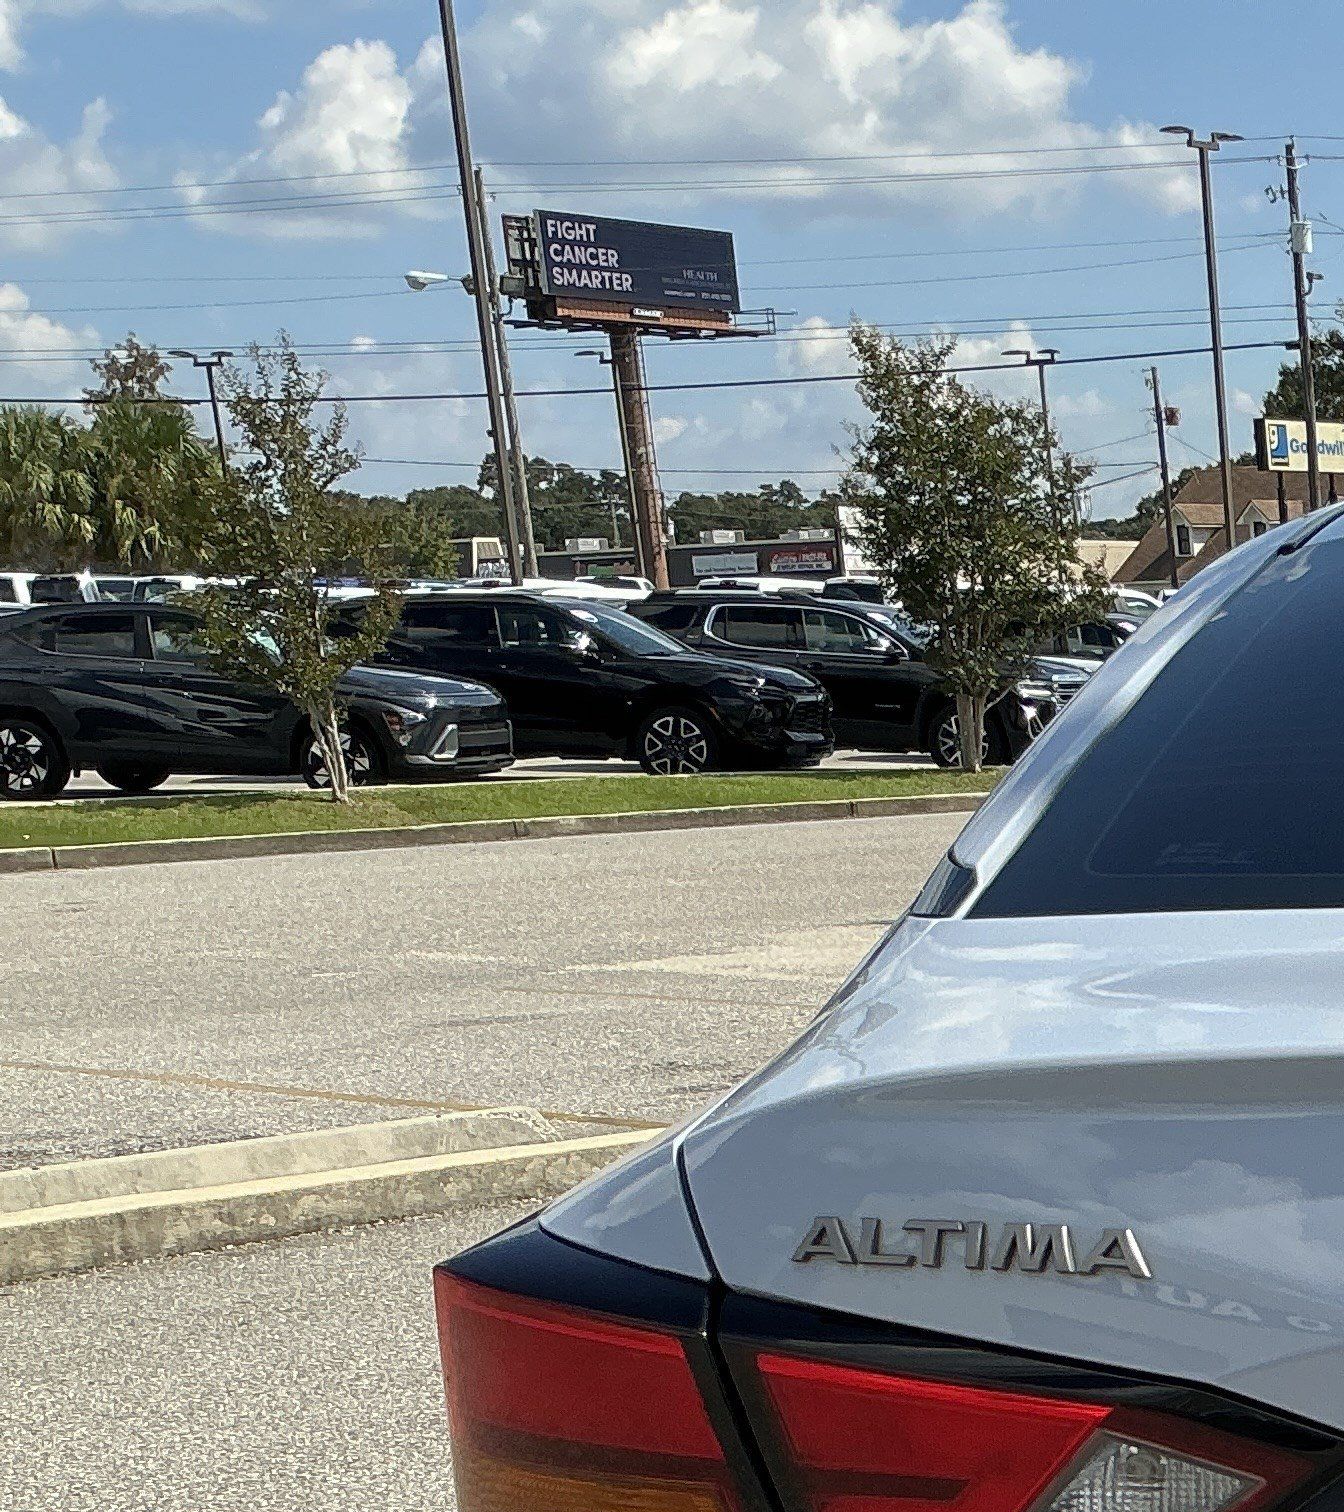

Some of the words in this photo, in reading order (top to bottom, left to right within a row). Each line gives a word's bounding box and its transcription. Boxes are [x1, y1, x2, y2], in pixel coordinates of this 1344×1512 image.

[547, 219, 597, 242] FIGHT
[549, 243, 619, 269] CANCER
[552, 267, 634, 292] SMARTER
[791, 1215, 1153, 1279] ALTIMA
